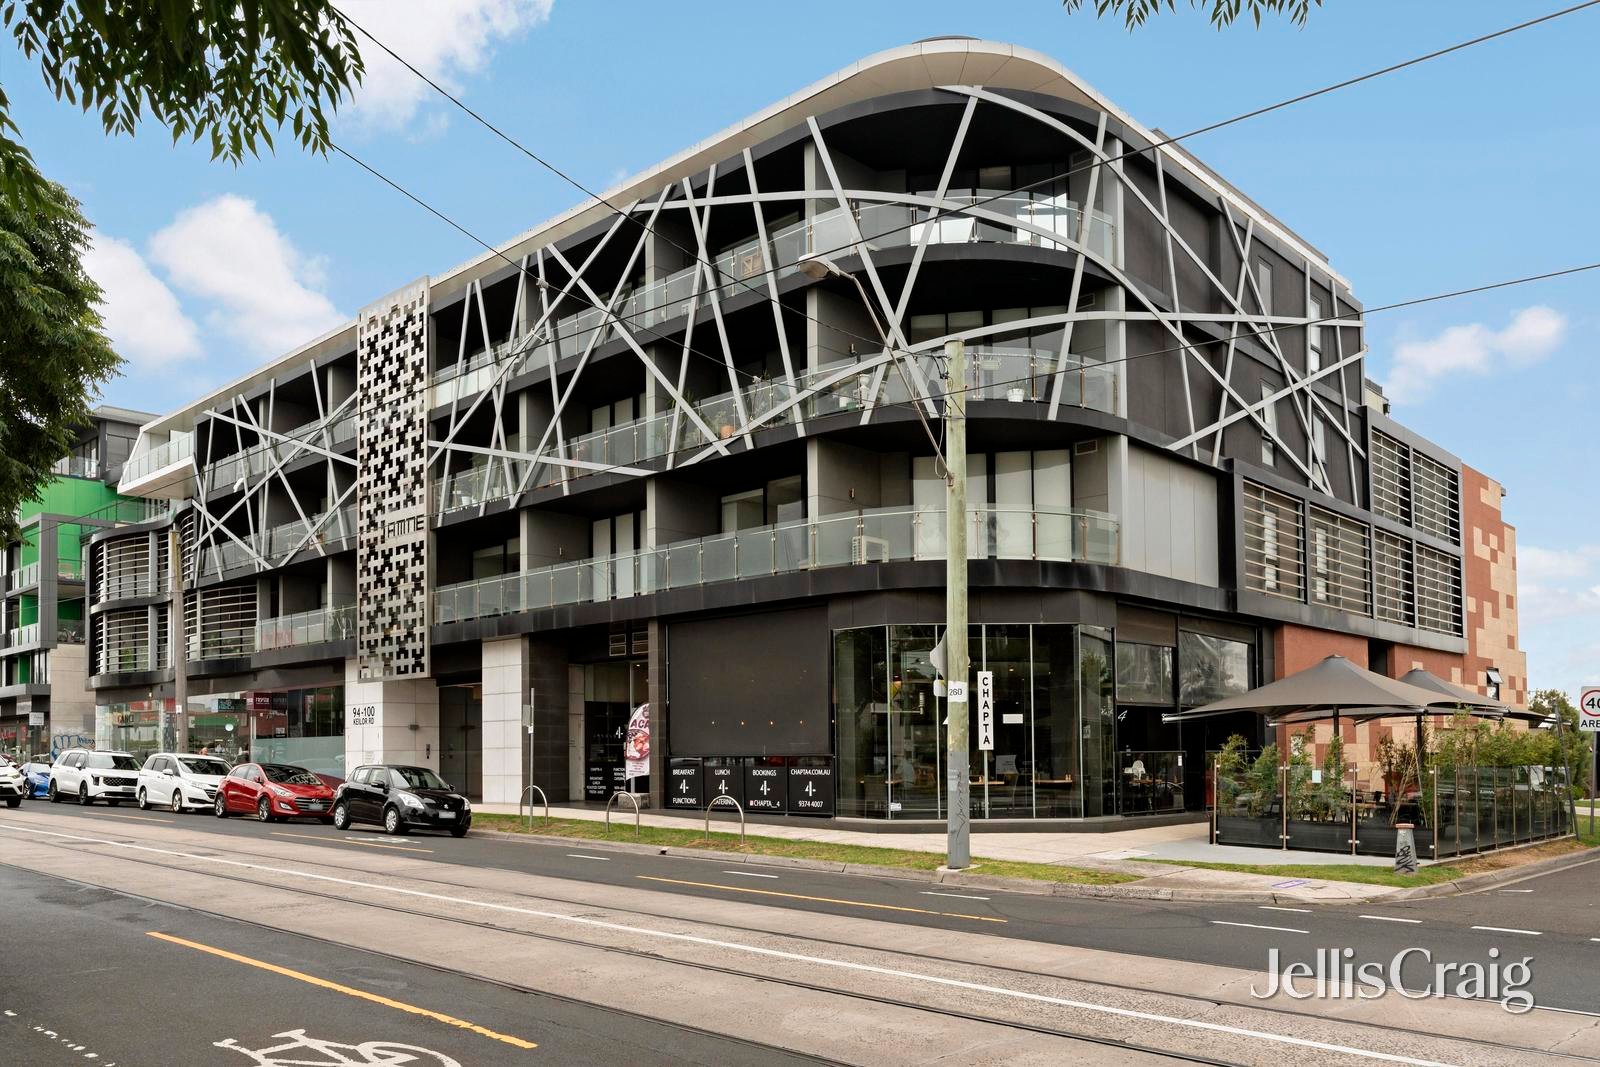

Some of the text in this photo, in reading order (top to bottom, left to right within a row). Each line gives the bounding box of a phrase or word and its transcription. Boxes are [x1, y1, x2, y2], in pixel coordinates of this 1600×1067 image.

[949, 688, 963, 696] 260
[353, 706, 375, 717] 94-100
[982, 677, 990, 744] CHAPTA
[353, 718, 367, 726] KEILOR
[672, 797, 697, 805] FUNCTIONS
